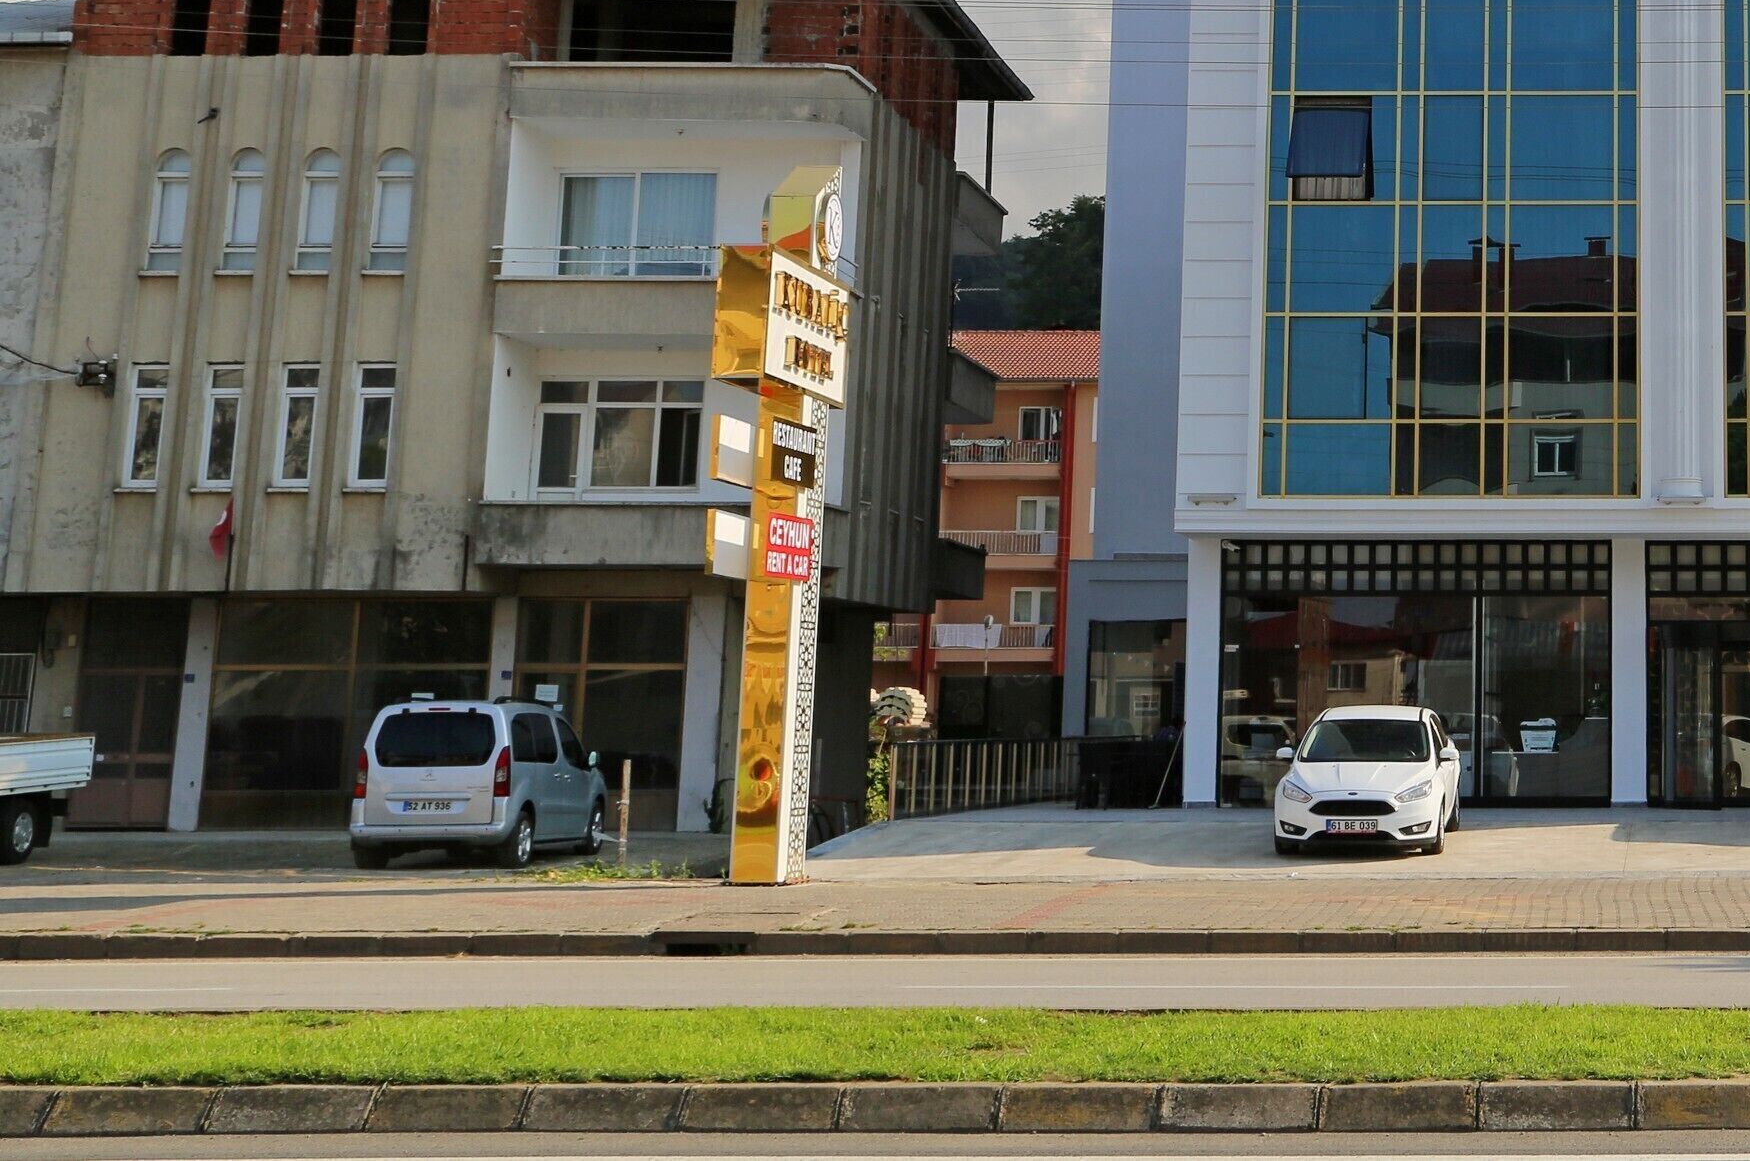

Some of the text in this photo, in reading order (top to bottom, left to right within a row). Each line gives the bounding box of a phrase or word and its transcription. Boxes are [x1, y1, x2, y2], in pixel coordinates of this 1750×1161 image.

[773, 421, 816, 455] RESTAURANT
[784, 454, 802, 481] CAFE
[769, 518, 810, 549] CEYHUN
[767, 551, 809, 576] RENT A CAR
[1331, 821, 1376, 830] 61 BE 039
